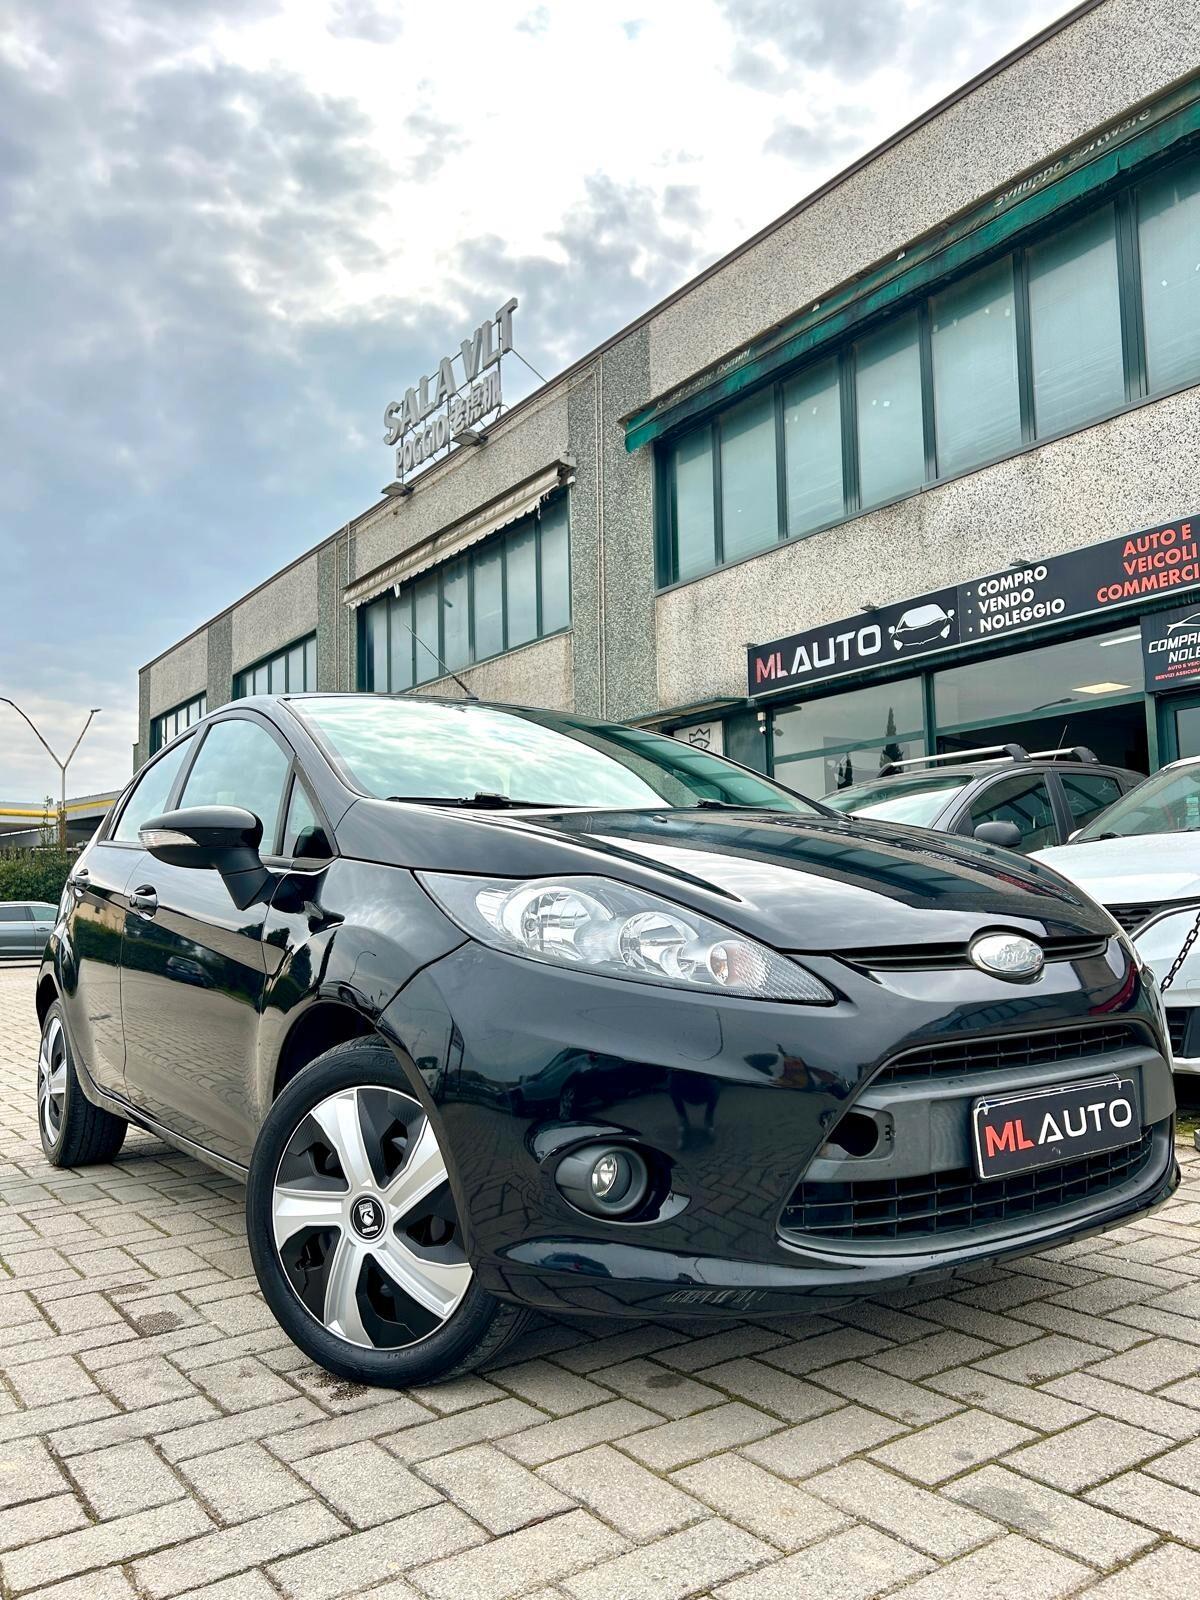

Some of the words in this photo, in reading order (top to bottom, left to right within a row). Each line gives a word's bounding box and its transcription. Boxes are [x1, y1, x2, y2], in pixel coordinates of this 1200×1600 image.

[383, 356, 457, 446] SALA
[460, 297, 518, 382] VLT
[396, 414, 450, 479] POGGIO
[1122, 528, 1177, 558] AUTO
[1181, 523, 1192, 541] E
[1123, 542, 1198, 576] VEICOLI
[977, 565, 1048, 598] COMPRO
[1096, 562, 1200, 604] COMMERCI
[978, 587, 1035, 615] VENDO
[979, 598, 1066, 634] NOLEGGIO
[755, 651, 789, 684] ML
[790, 624, 882, 675] AUTO
[1148, 630, 1200, 654] COMPR
[985, 1119, 1035, 1158] ML
[1037, 1098, 1132, 1145] AUTO
